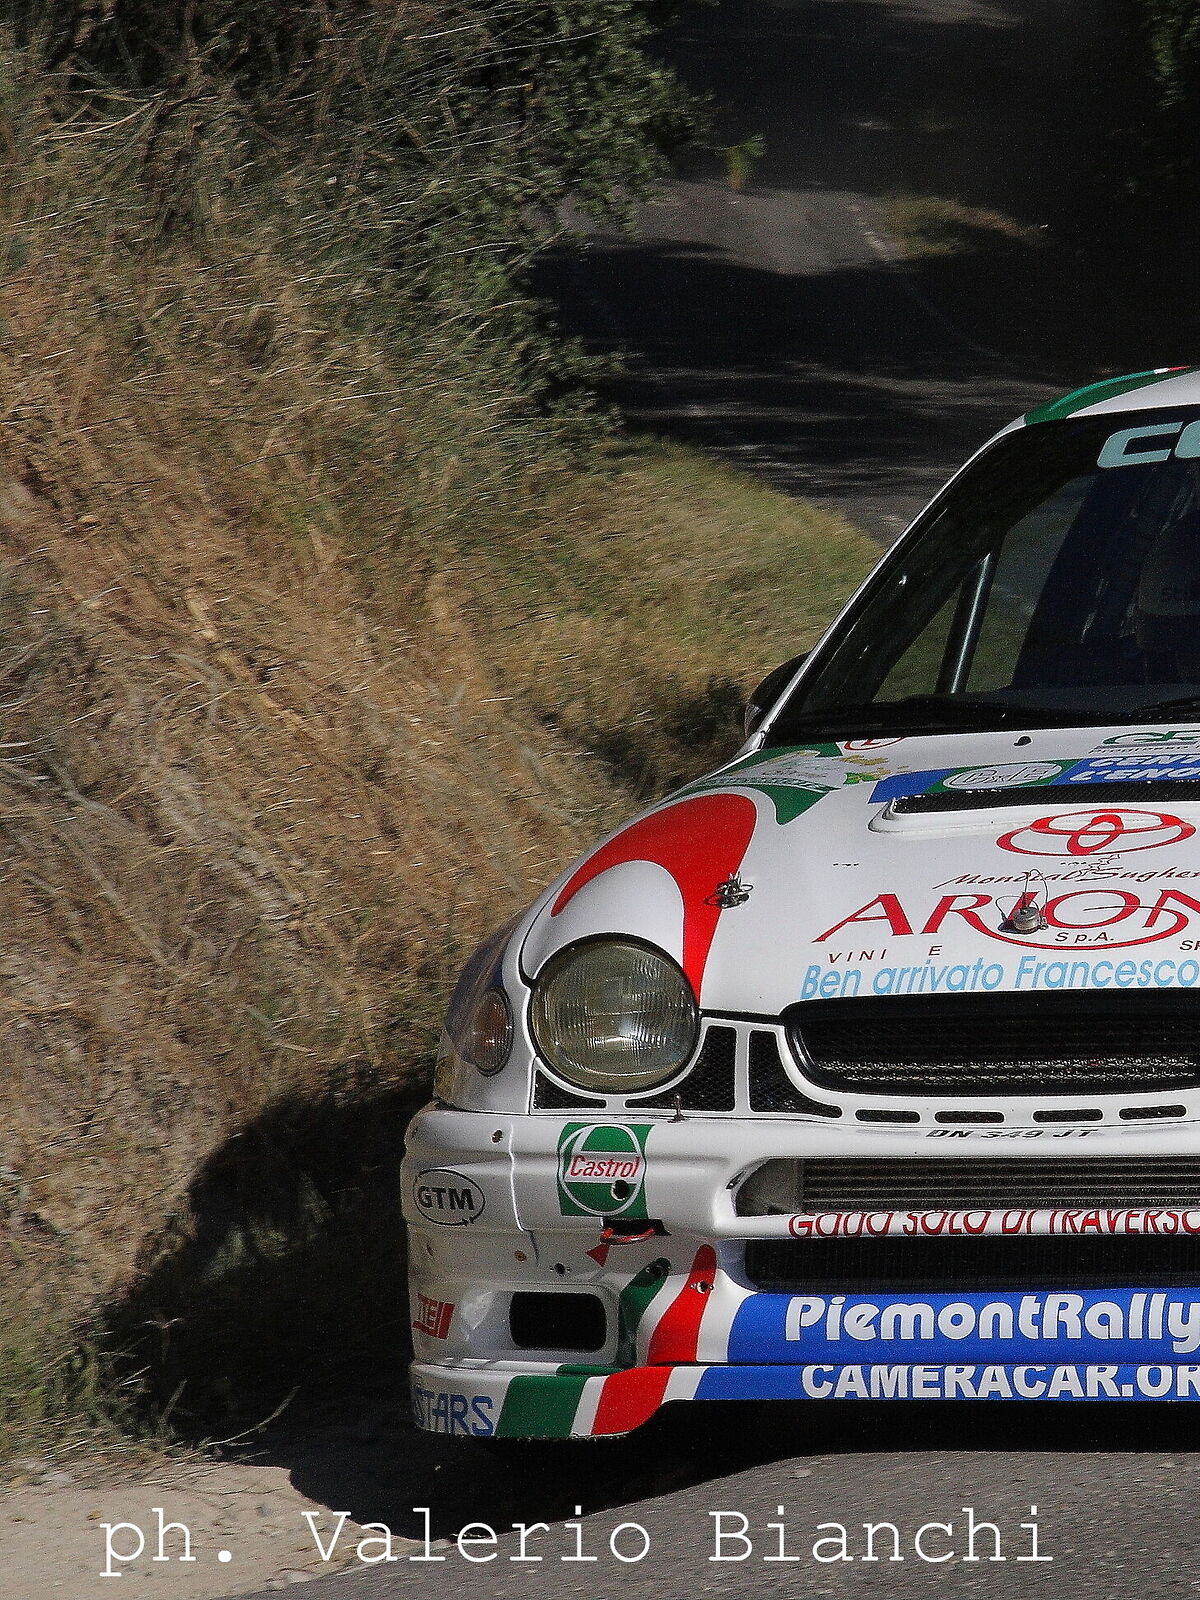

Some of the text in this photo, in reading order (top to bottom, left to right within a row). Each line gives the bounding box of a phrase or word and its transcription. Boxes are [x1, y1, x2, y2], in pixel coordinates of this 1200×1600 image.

[828, 944, 942, 964] VINI E
[800, 964, 867, 1000] Ben
[871, 957, 1004, 996] arrivato
[1015, 953, 1200, 991] Francesco
[569, 1155, 642, 1179] Castrol
[416, 1185, 476, 1212] GTM
